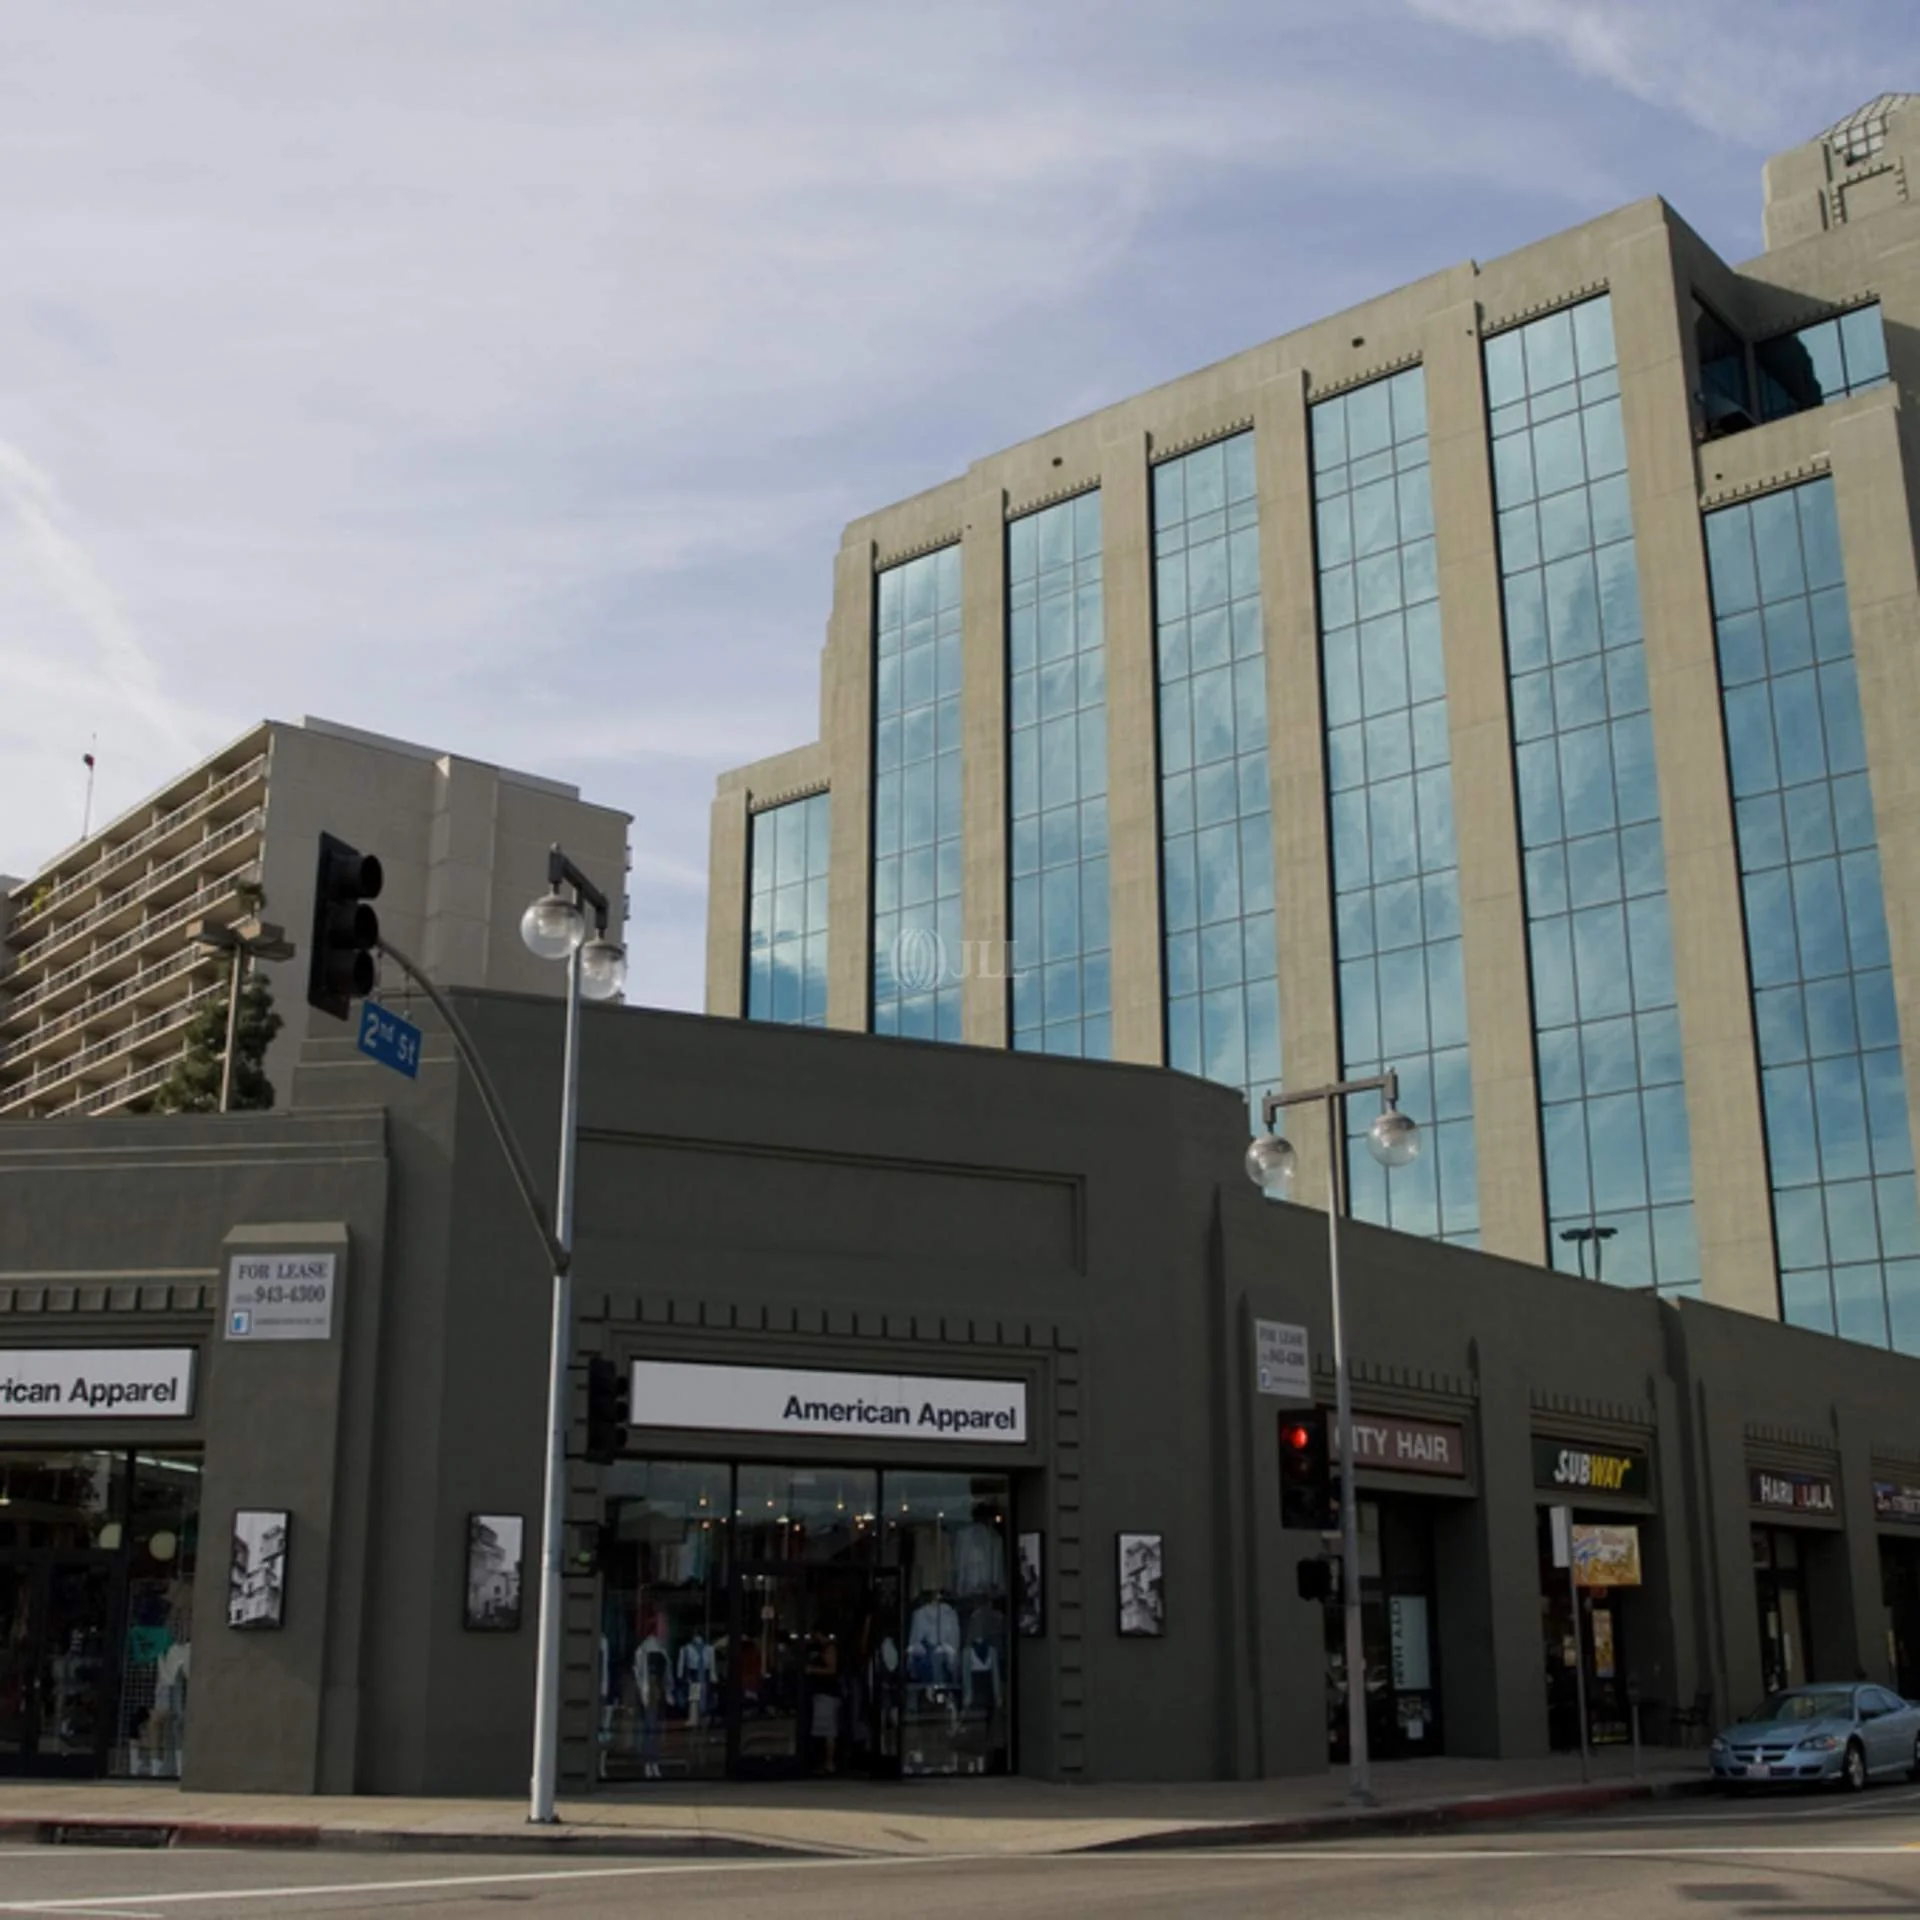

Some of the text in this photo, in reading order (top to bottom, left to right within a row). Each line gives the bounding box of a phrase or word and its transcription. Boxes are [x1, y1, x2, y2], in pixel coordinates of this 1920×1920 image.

[364, 1012, 416, 1065] 2nd St
[239, 1262, 328, 1280] FOR LEASE
[69, 1377, 178, 1407] Apparel
[783, 1396, 1016, 1432] American Apparel
[1396, 1429, 1449, 1463] HAIR
[1553, 1448, 1632, 1489] SUBWAY
